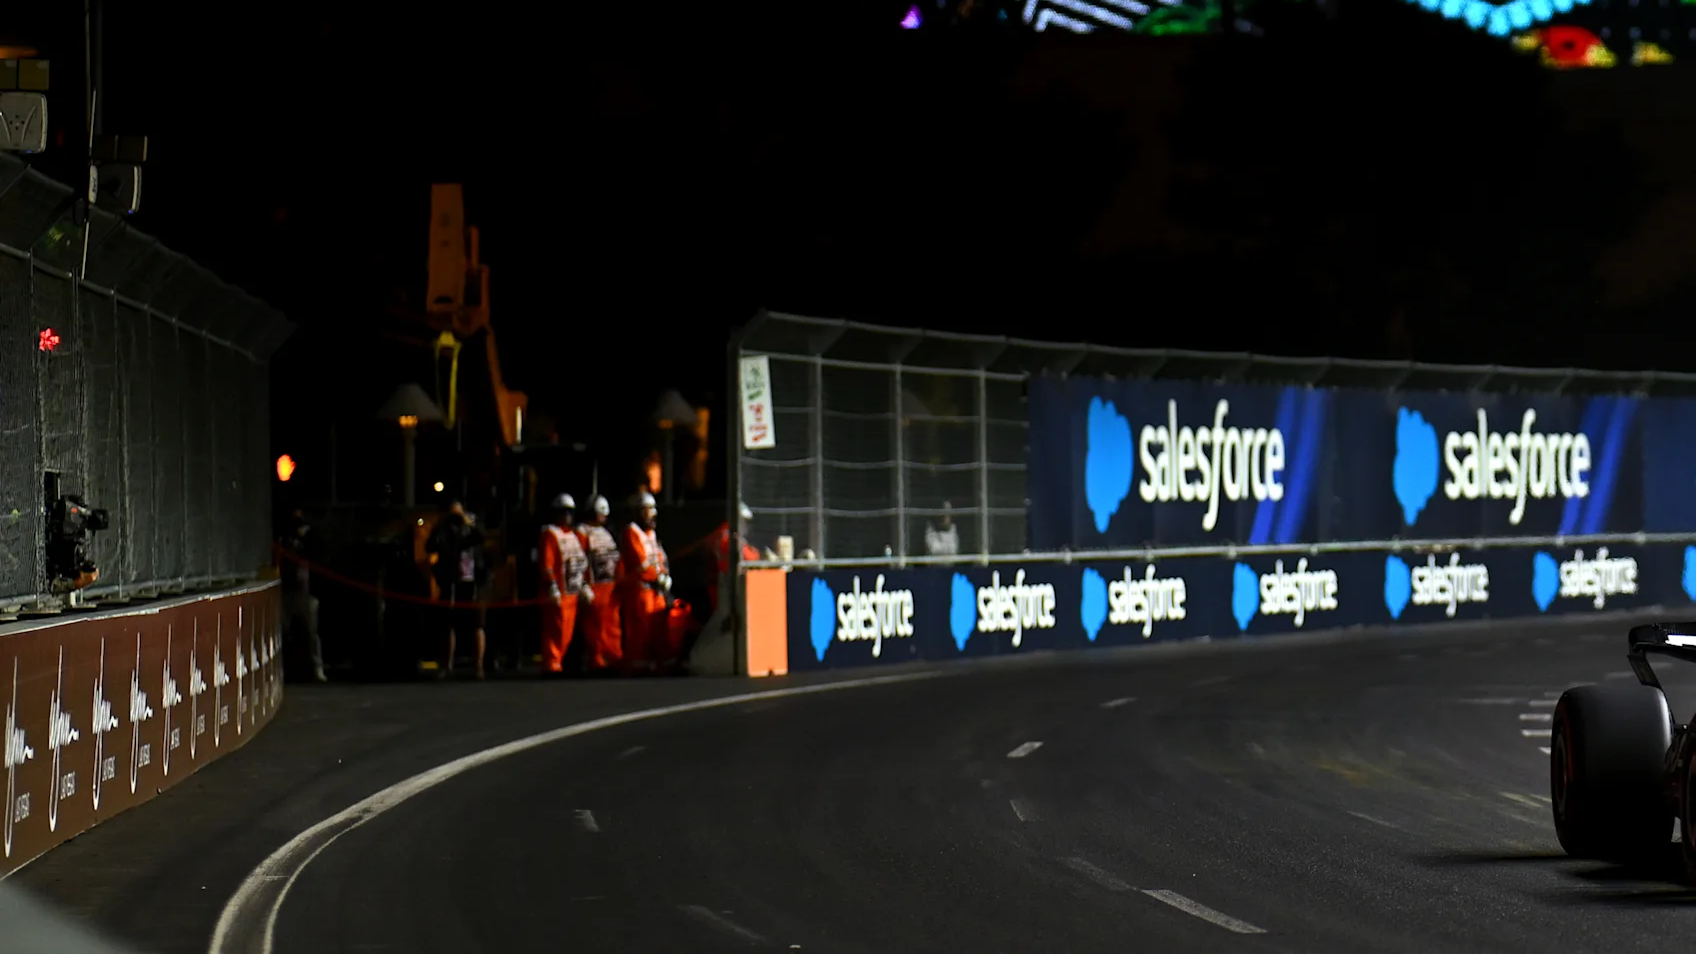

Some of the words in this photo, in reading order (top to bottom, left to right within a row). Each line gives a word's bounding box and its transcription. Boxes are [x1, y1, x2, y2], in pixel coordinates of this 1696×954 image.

[1138, 398, 1285, 532] salesforce
[1444, 407, 1592, 525] salesforce
[836, 573, 914, 658] salesforce
[977, 568, 1056, 647] salesforce
[1108, 564, 1187, 638] salesforce
[1259, 558, 1339, 627] salesforce
[1411, 553, 1490, 617] salesforce
[1559, 547, 1638, 610] salesforce
